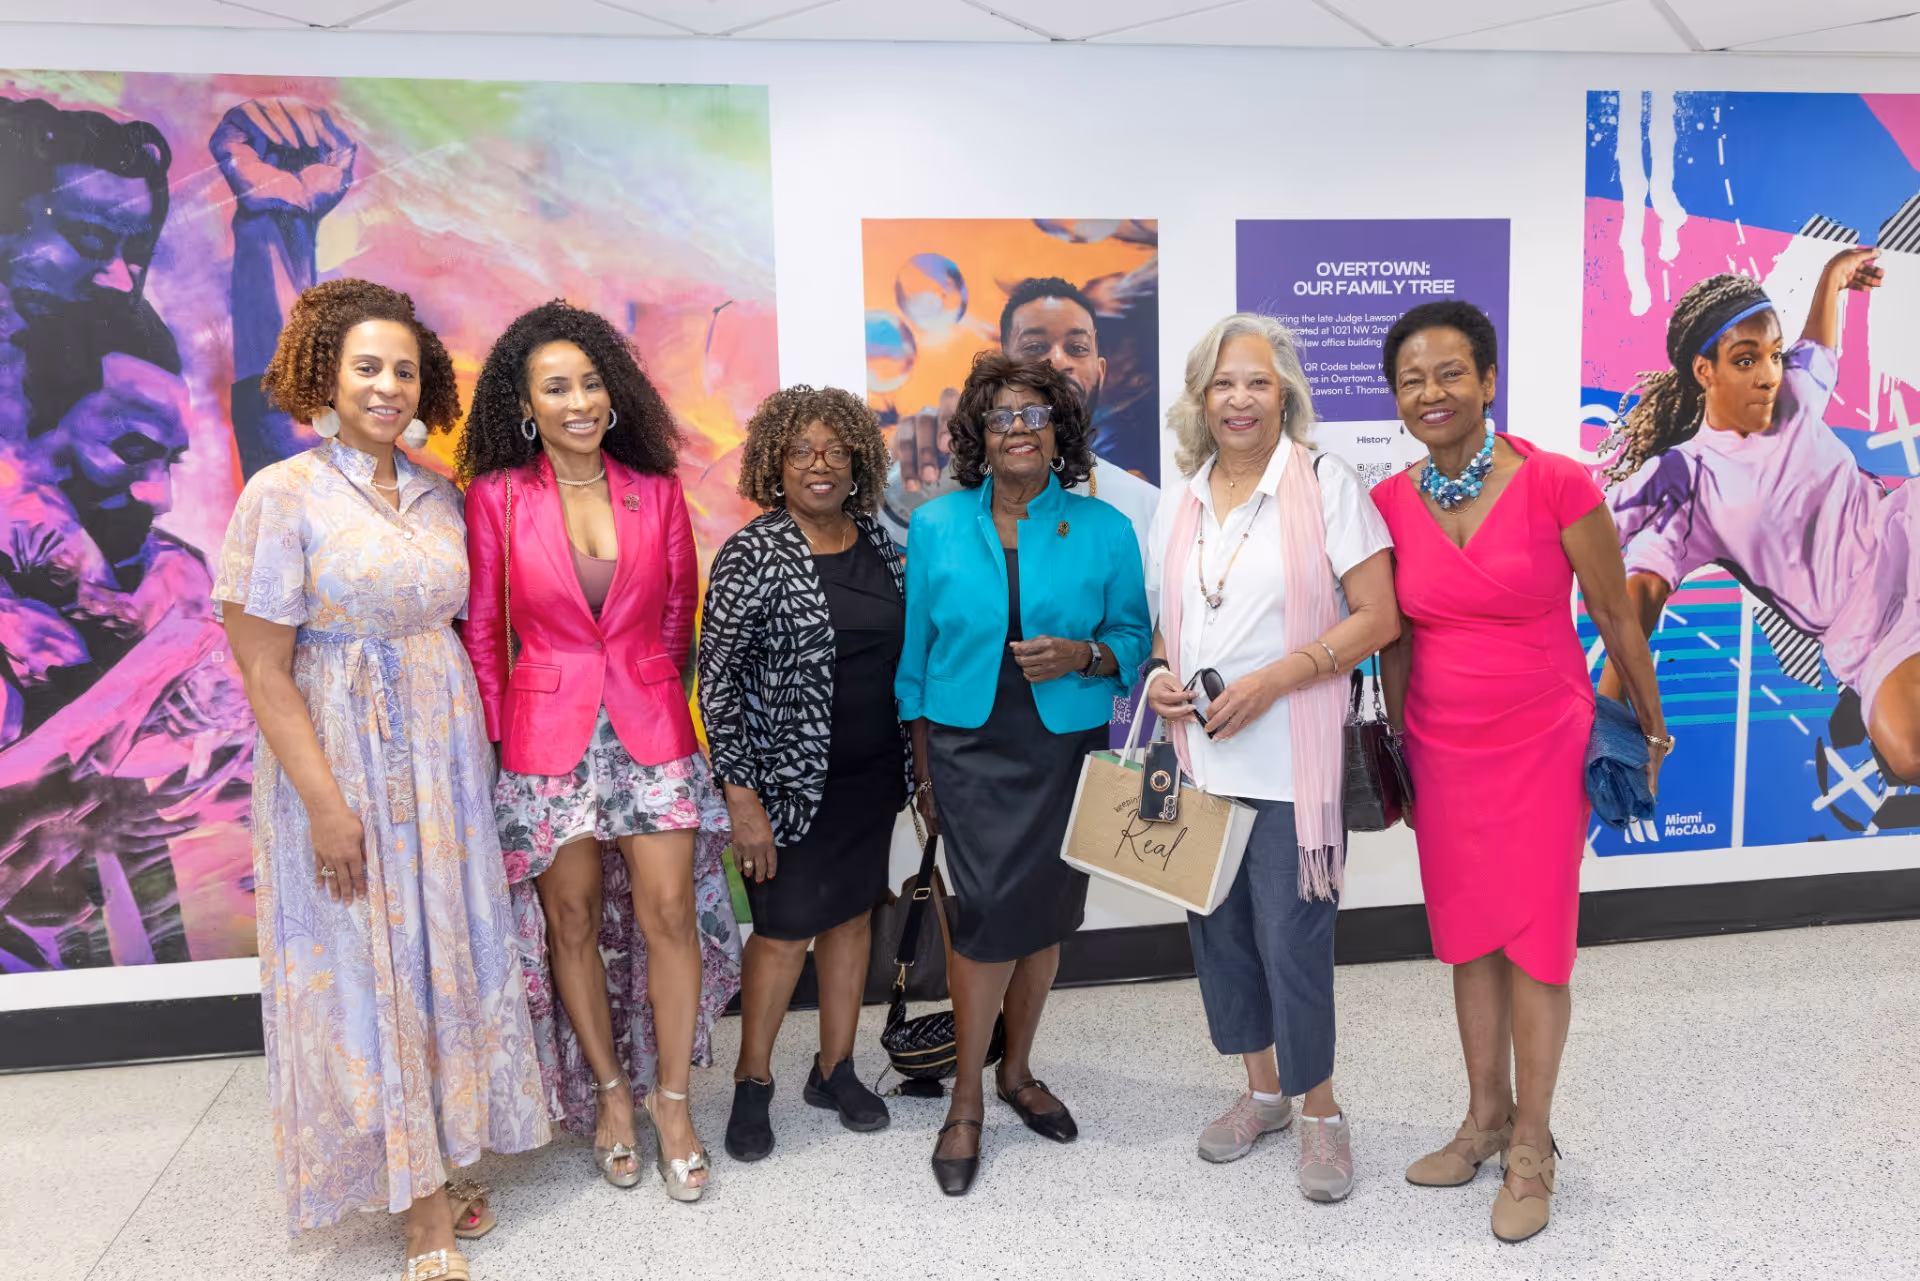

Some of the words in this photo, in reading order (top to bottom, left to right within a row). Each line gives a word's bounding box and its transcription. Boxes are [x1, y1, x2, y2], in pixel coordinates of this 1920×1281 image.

[1316, 261, 1431, 277] OVERTOWN:
[1293, 280, 1334, 296] OUR
[1335, 279, 1406, 296] FAMILY
[1408, 279, 1455, 294] TREE
[1301, 314, 1316, 323] the
[1317, 314, 1333, 323] late
[1335, 313, 1363, 325] Judge
[1364, 312, 1397, 322] Lawson
[1321, 327, 1330, 335] at
[1331, 325, 1351, 335] 1021
[1353, 325, 1370, 335] NW
[1371, 325, 1389, 335] 2nd
[1304, 339, 1320, 348] law
[1321, 338, 1346, 347] office
[1347, 337, 1382, 348] building
[1304, 362, 1318, 372] QR
[1320, 361, 1349, 371] Codes
[1350, 361, 1376, 370] below
[1321, 374, 1330, 383] in
[1310, 386, 1343, 396] Lawson
[1345, 385, 1354, 395] E.
[1355, 384, 1390, 395] Thomas
[1357, 436, 1392, 445] History
[1665, 811, 1702, 825] Miami
[1665, 823, 1716, 836] MoCAAD
[1114, 808, 1188, 872] Real
